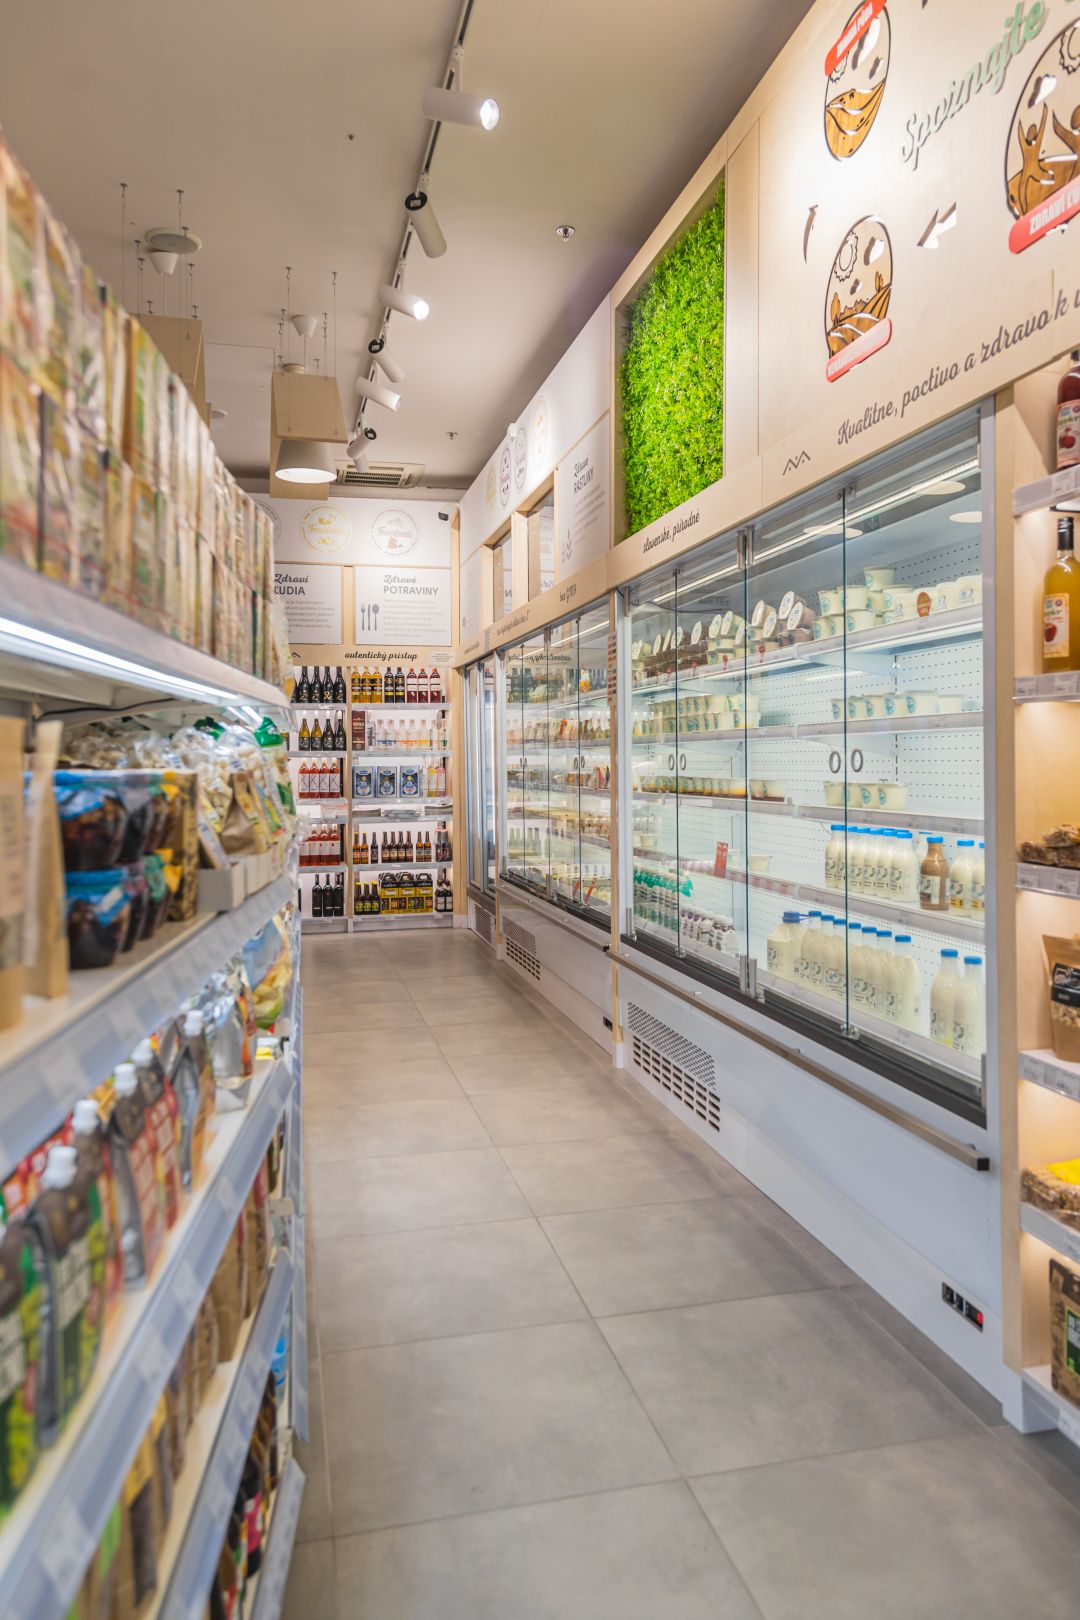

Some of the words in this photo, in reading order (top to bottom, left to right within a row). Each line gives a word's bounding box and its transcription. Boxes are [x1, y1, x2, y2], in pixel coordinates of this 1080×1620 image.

[900, 362, 959, 418] poctivo
[963, 353, 976, 372] a
[980, 309, 1052, 363] zdravo
[1054, 288, 1069, 320] k
[383, 585, 439, 596] POTRAVINY
[344, 651, 386, 661] autentický
